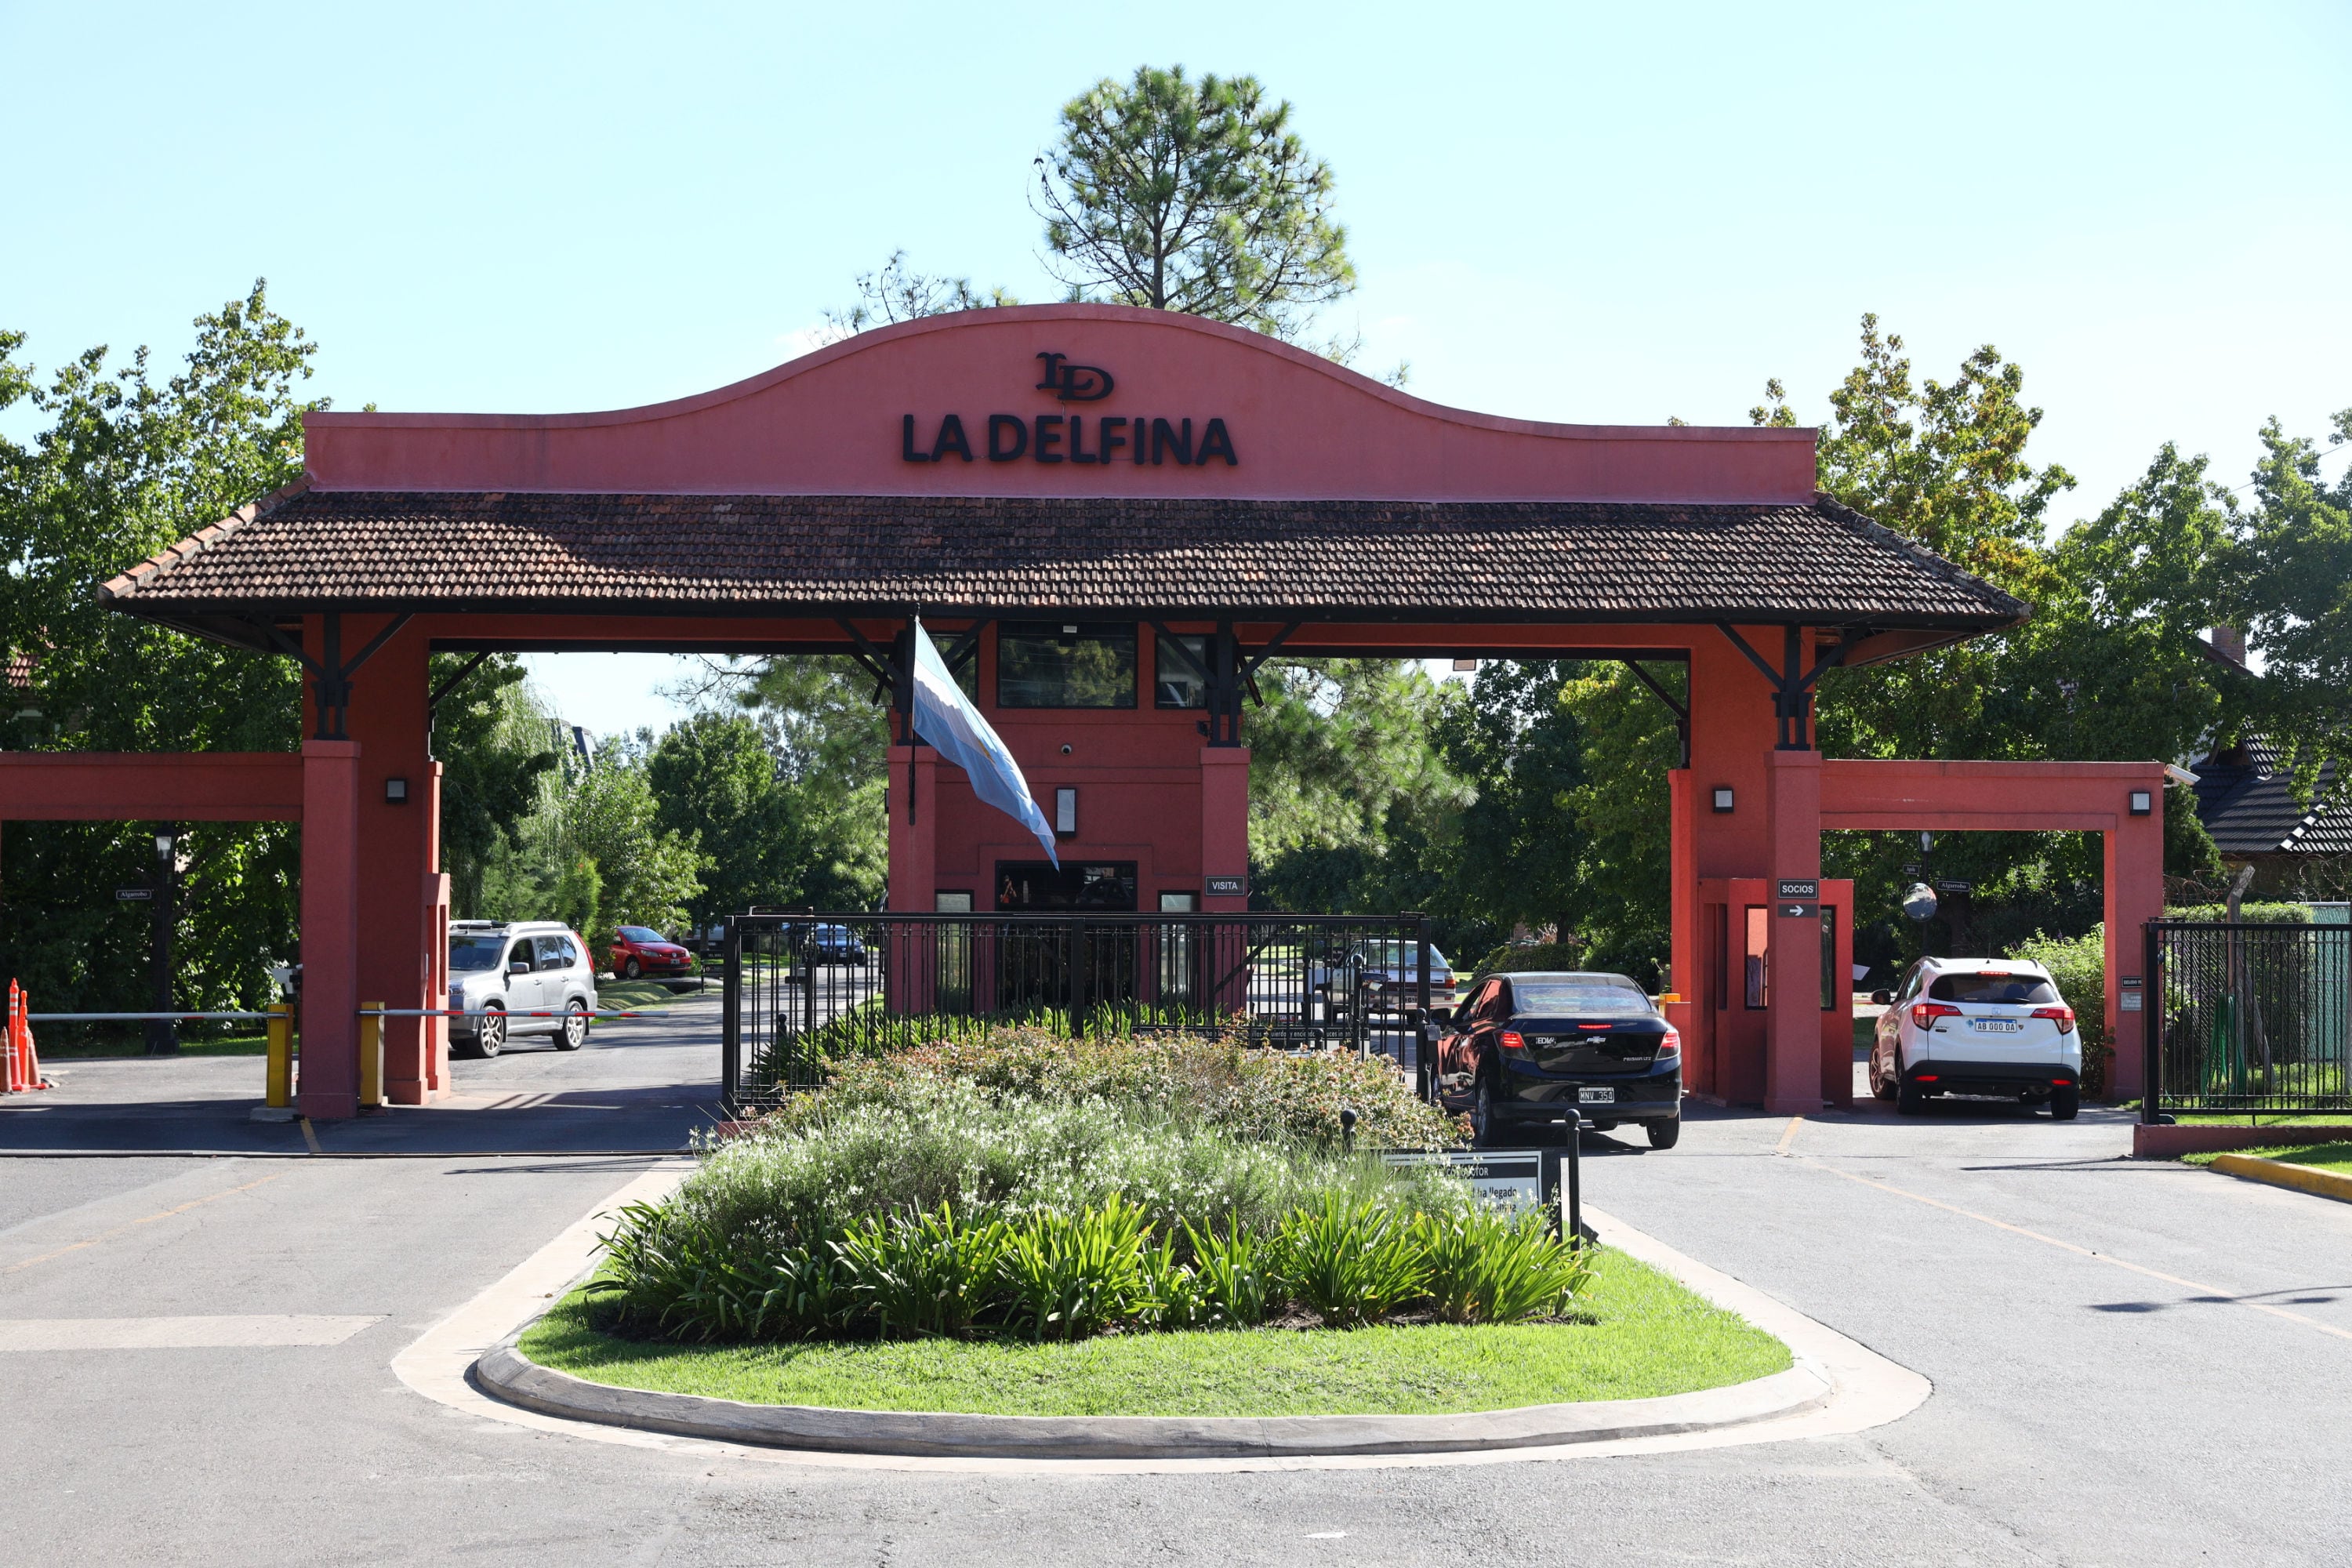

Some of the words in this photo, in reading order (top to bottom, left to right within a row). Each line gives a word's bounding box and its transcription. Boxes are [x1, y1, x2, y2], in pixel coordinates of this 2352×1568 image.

[903, 414, 972, 461] LA
[989, 415, 1238, 466] DELFINA
[1211, 881, 1238, 890] VISITA
[1581, 1091, 1594, 1100] MNV
[1599, 1091, 1613, 1100] 354
